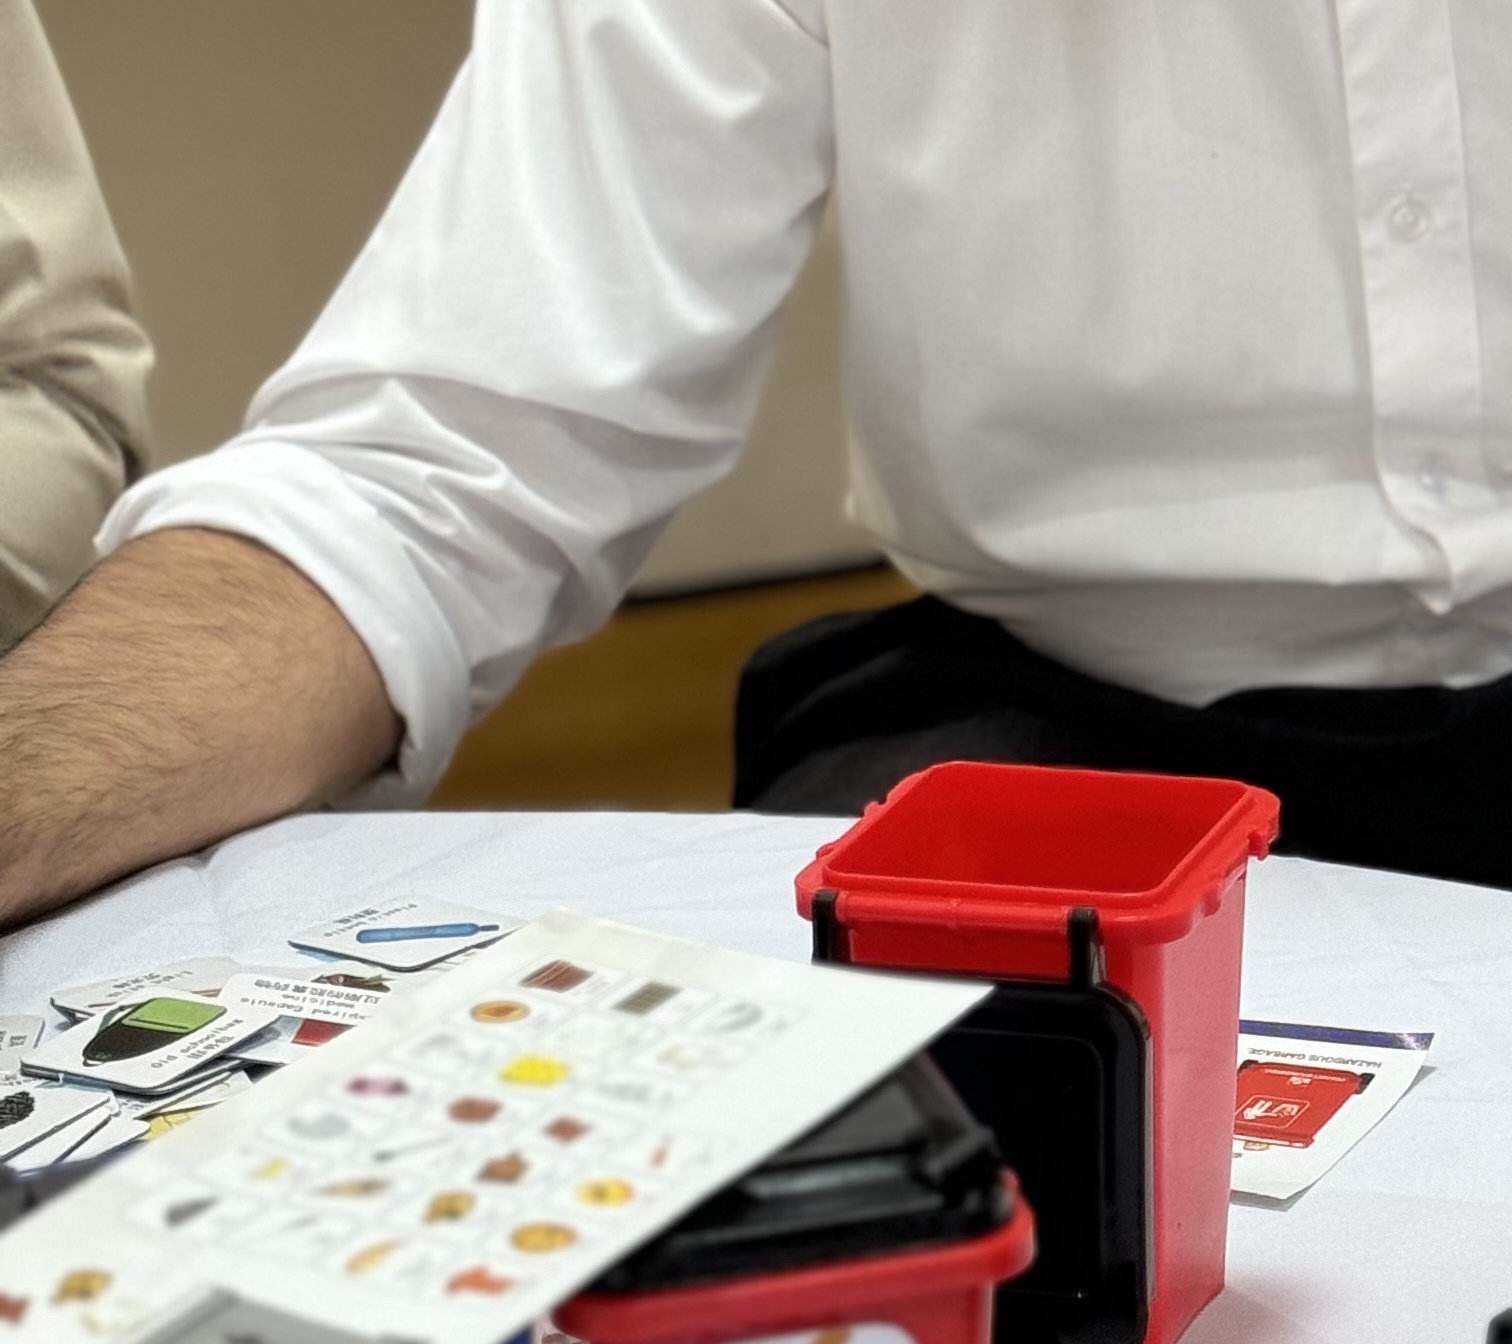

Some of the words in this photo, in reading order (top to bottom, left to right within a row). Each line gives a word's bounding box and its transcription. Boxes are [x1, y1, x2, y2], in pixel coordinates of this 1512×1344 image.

[1248, 1047, 1306, 1060] GARBAGE
[151, 1054, 178, 1069] Old
[1308, 1054, 1383, 1069] HAZARDOUS
